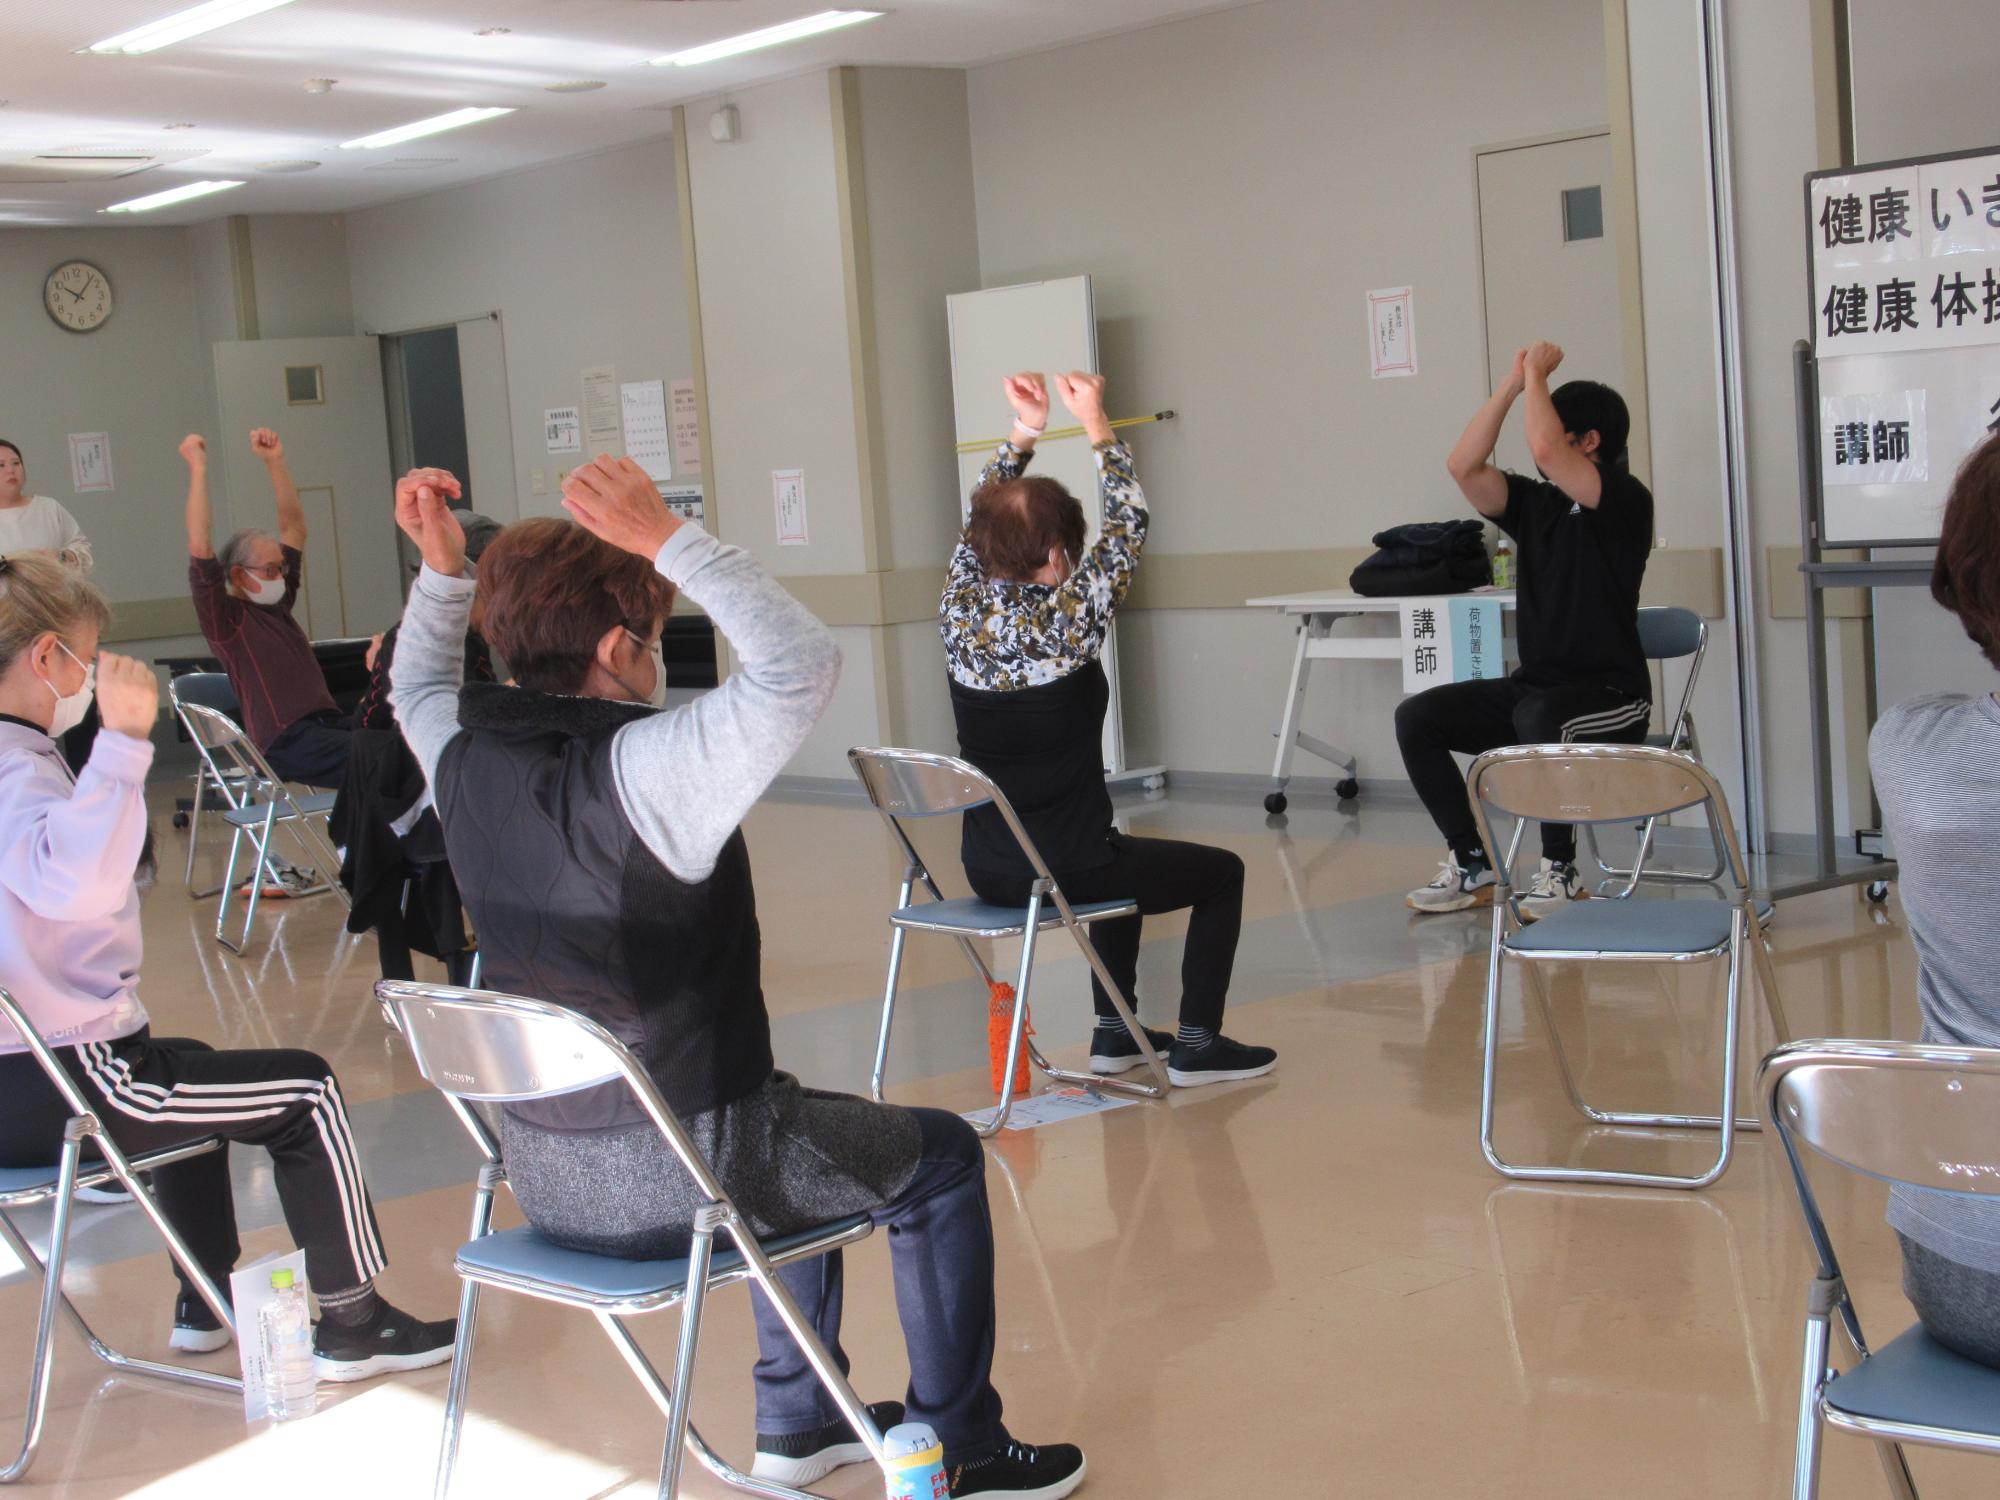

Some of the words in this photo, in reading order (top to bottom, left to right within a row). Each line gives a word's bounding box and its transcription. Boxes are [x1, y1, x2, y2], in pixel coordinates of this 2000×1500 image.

[1833, 420, 1910, 466] 講師
[1412, 608, 1437, 675] 講師
[1469, 607, 1484, 680] 荷物置き場
